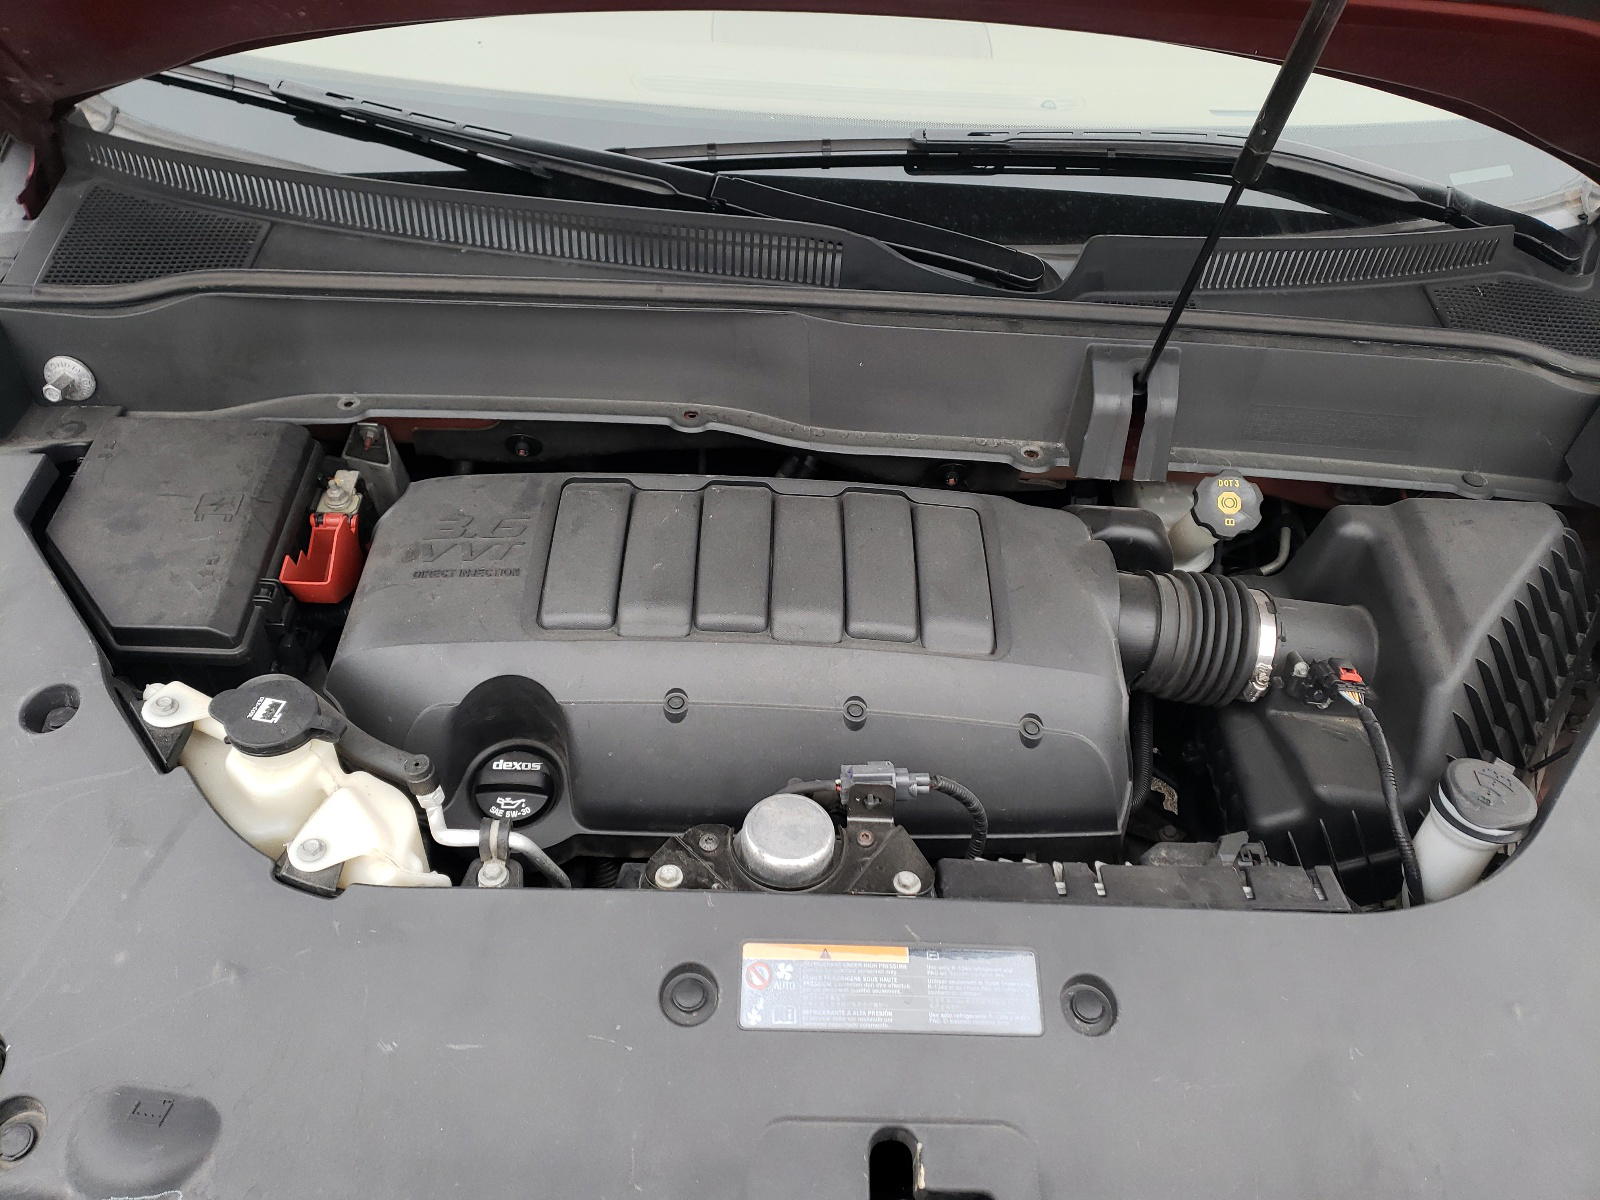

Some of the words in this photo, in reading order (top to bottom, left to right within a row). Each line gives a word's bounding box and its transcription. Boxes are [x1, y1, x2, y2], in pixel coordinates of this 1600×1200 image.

[412, 568, 456, 579] DIRECT
[458, 567, 521, 578] INJECTION
[492, 759, 544, 771] dexos
[489, 806, 505, 817] SAE
[505, 807, 531, 818] 5W-30
